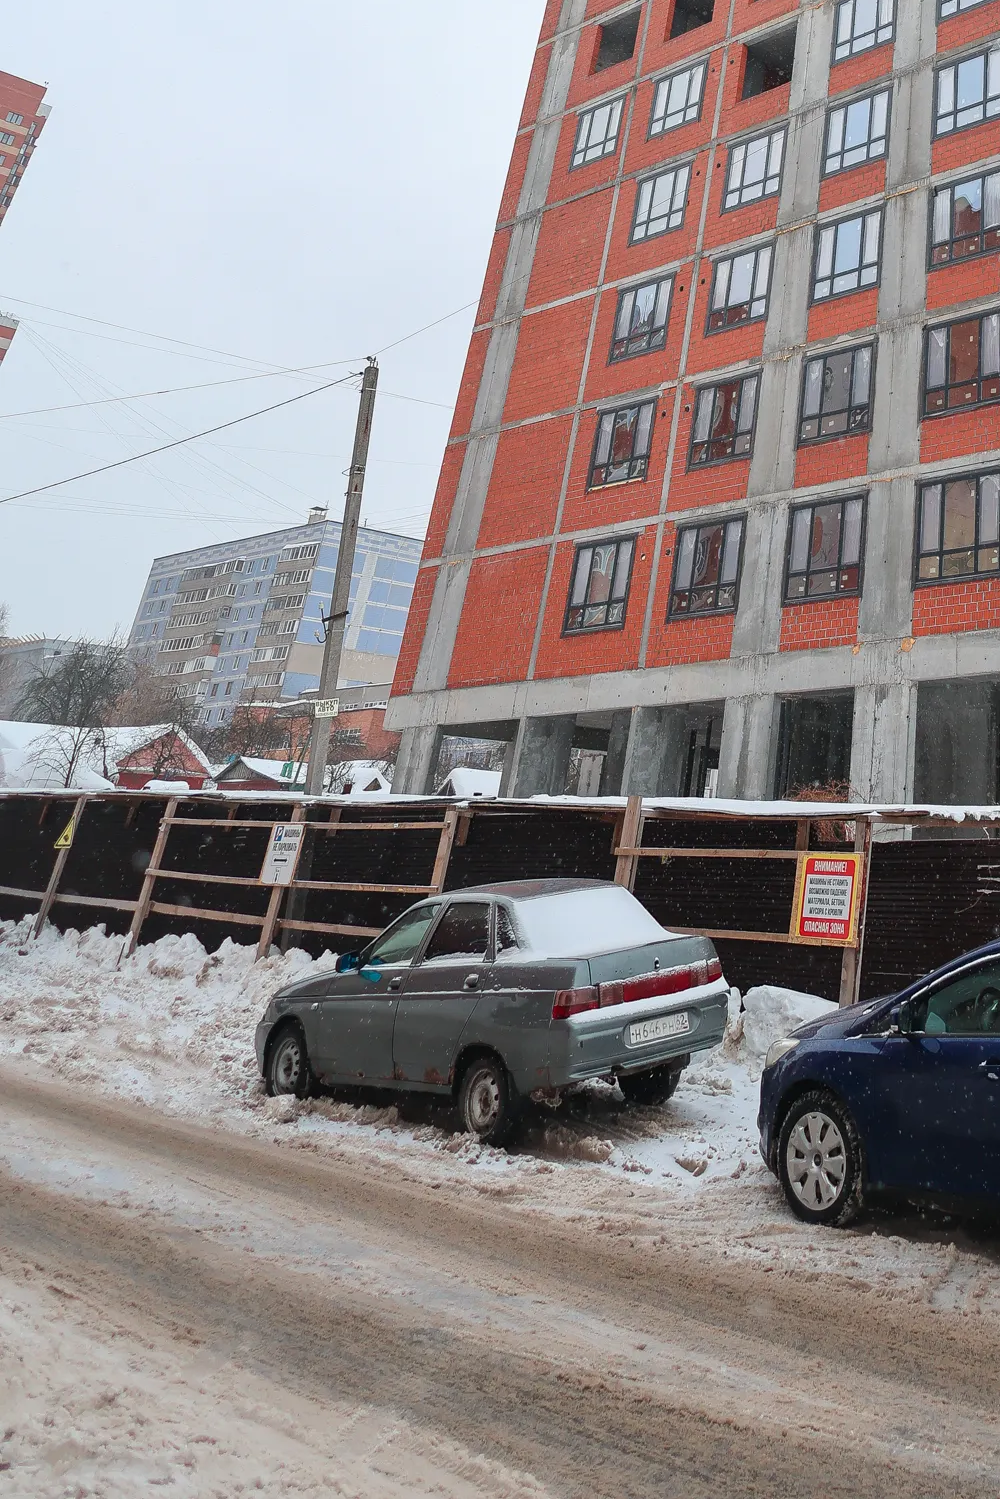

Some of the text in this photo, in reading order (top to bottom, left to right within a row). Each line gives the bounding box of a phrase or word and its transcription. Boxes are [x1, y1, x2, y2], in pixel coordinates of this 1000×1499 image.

[814, 861, 847, 872] ВНИМАНИЕ!
[832, 878, 848, 887] СТАВИТЬ
[808, 887, 847, 897] ВОЗМОЖНО ПАДЕНИЕ
[809, 907, 824, 915] МУСОРА
[828, 908, 843, 916] КРОВЛИ
[804, 921, 844, 934] ОПАСНАЯ ЗОНА
